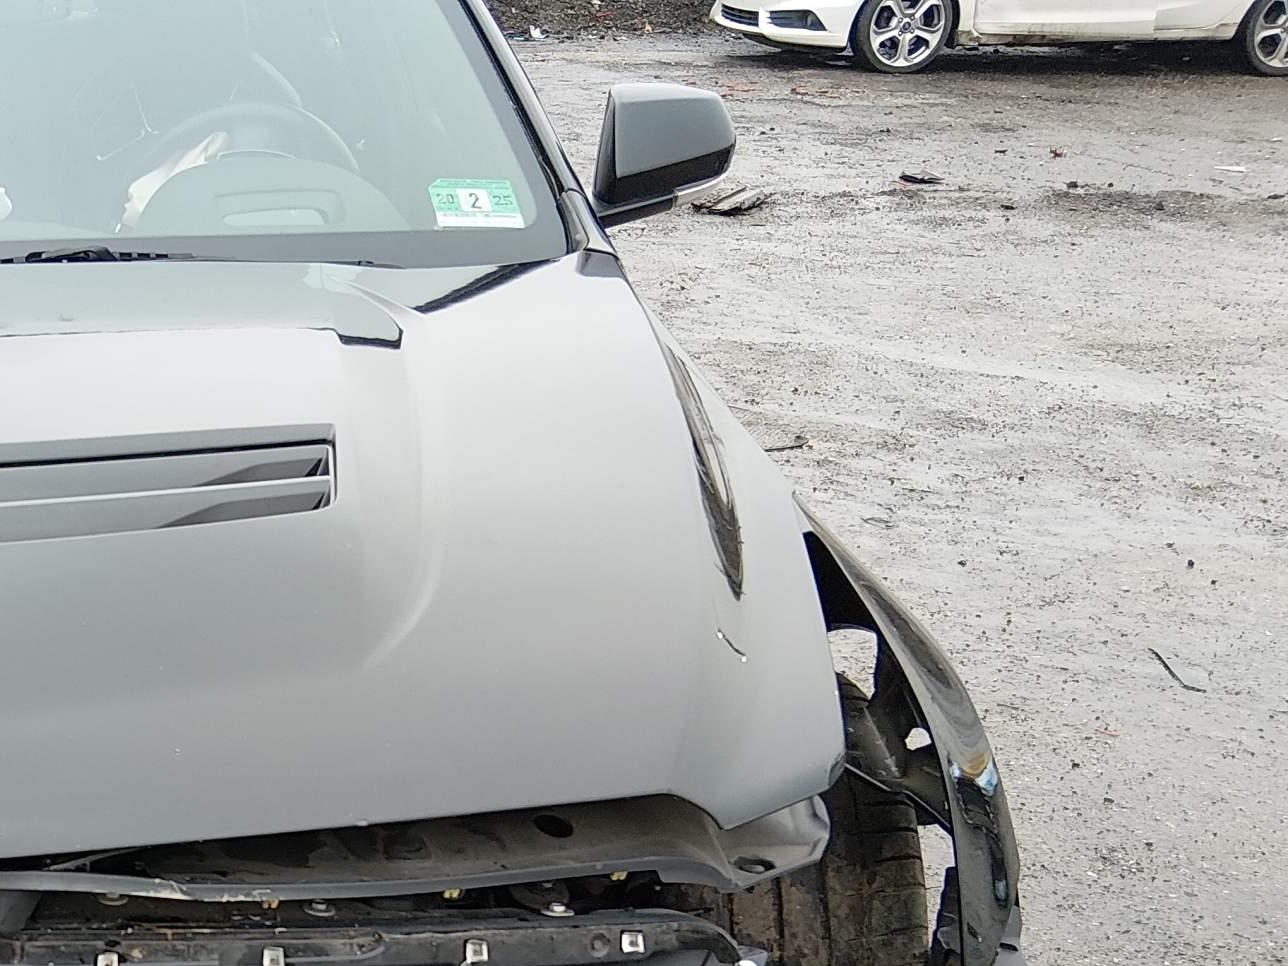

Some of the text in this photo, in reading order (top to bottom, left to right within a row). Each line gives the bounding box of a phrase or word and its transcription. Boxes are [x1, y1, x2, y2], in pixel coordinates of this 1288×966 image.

[436, 193, 455, 205] 20
[468, 192, 483, 210] 2
[492, 195, 514, 206] 25
